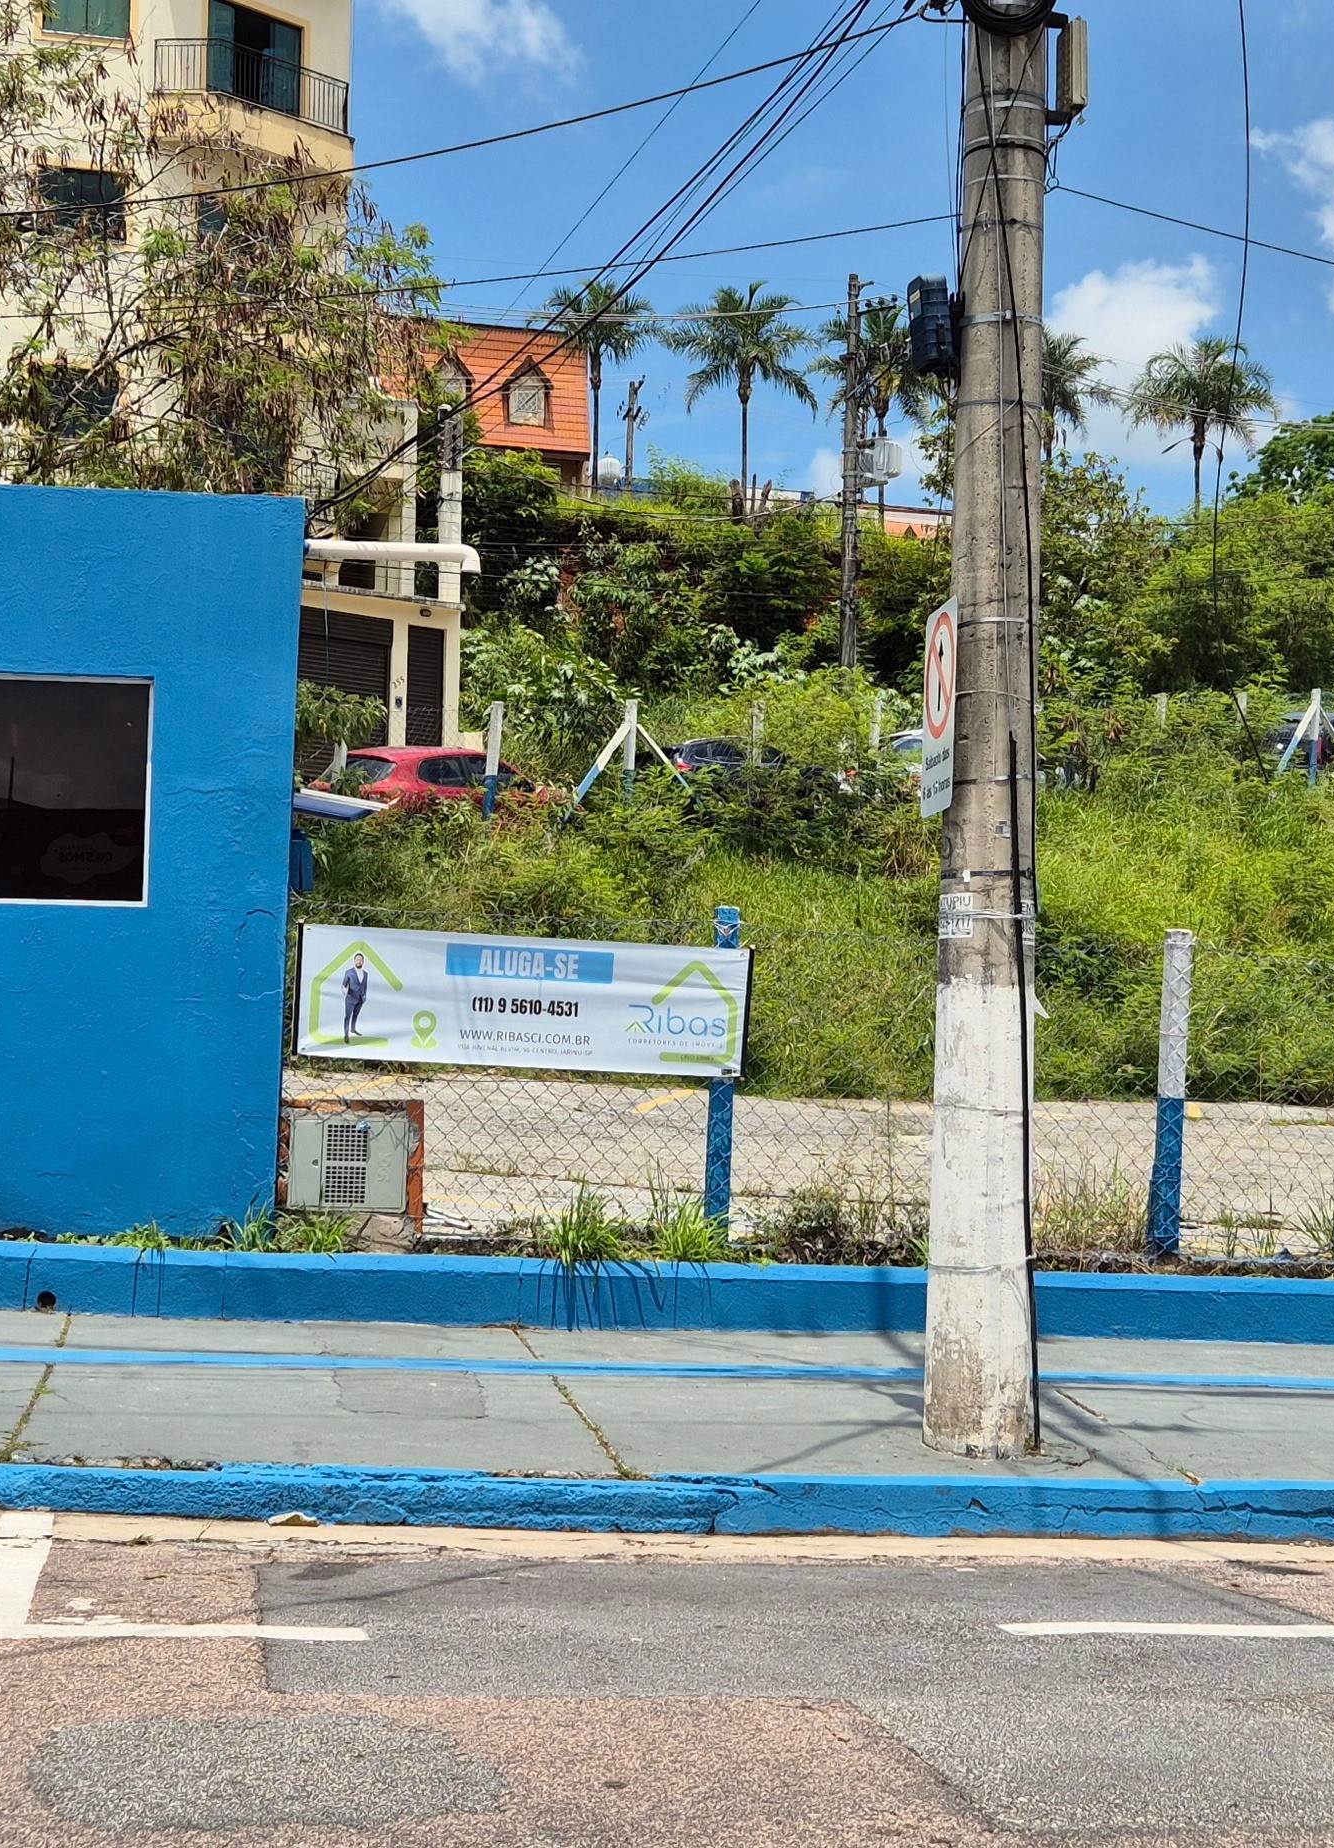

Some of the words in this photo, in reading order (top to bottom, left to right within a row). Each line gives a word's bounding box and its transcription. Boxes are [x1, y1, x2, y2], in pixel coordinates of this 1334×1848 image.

[478, 949, 579, 980] ALUGA-SE
[472, 996, 494, 1012] (11)
[498, 997, 506, 1013] 9
[511, 998, 579, 1017] 5610-4531
[628, 1004, 726, 1037] Ribas
[459, 1029, 591, 1046] WWW.RIBASCI.COM.BR
